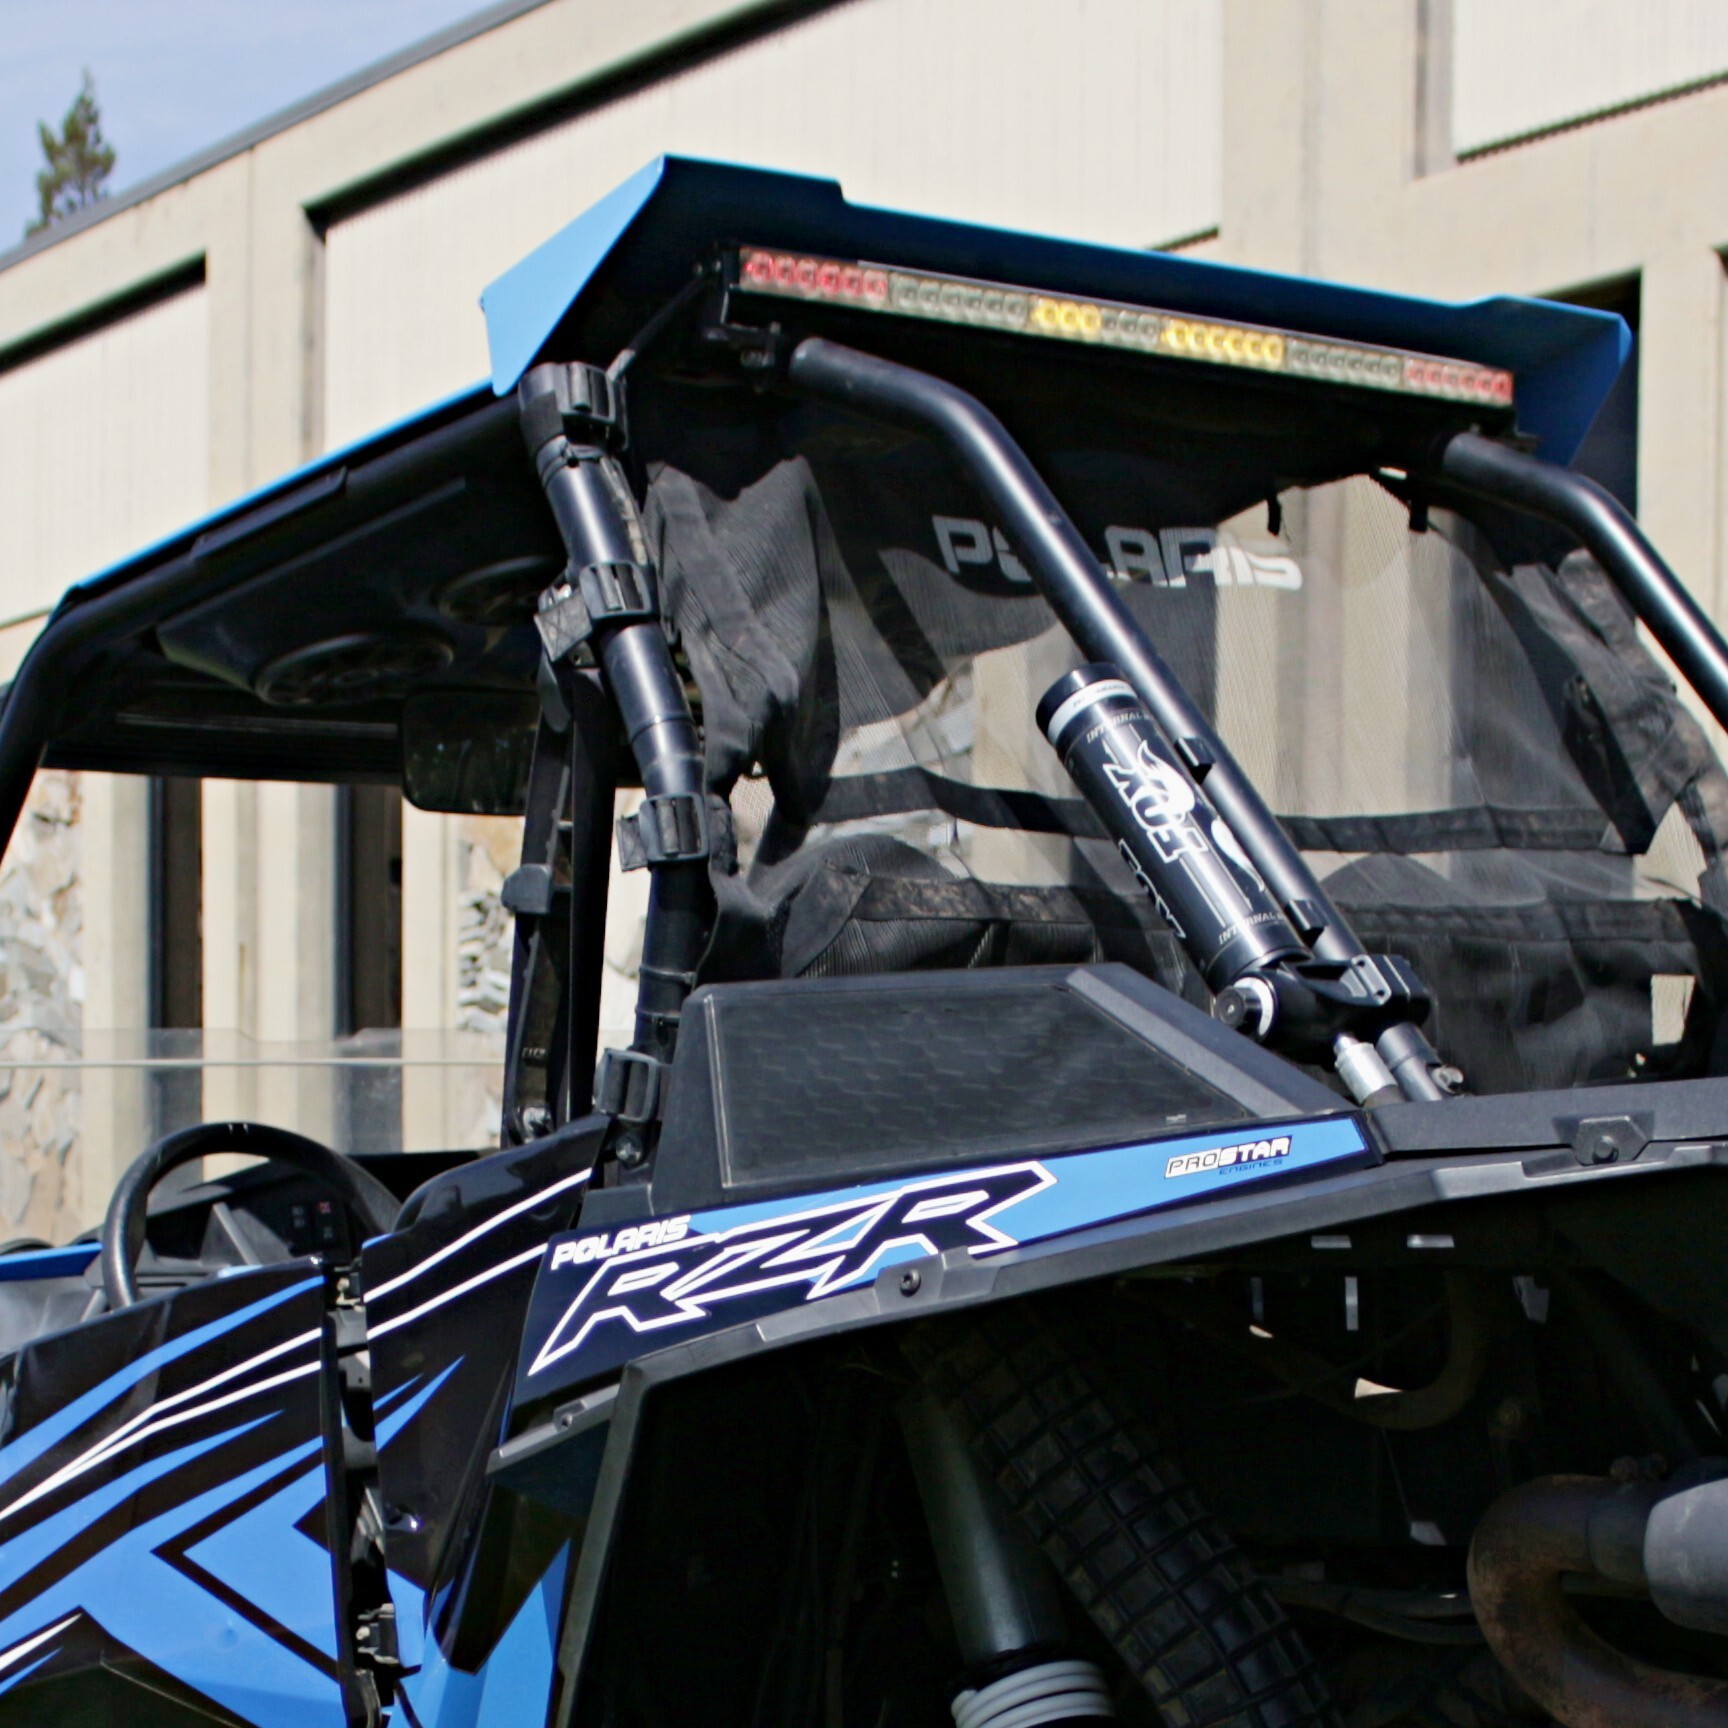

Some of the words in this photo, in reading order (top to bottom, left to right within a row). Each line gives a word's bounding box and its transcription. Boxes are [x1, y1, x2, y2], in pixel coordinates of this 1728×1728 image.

[1167, 1136, 1290, 1177] PROSTAR
[1218, 1158, 1283, 1175] ENGINES
[550, 1214, 692, 1270] POLARIS
[528, 1160, 1058, 1376] RZR
